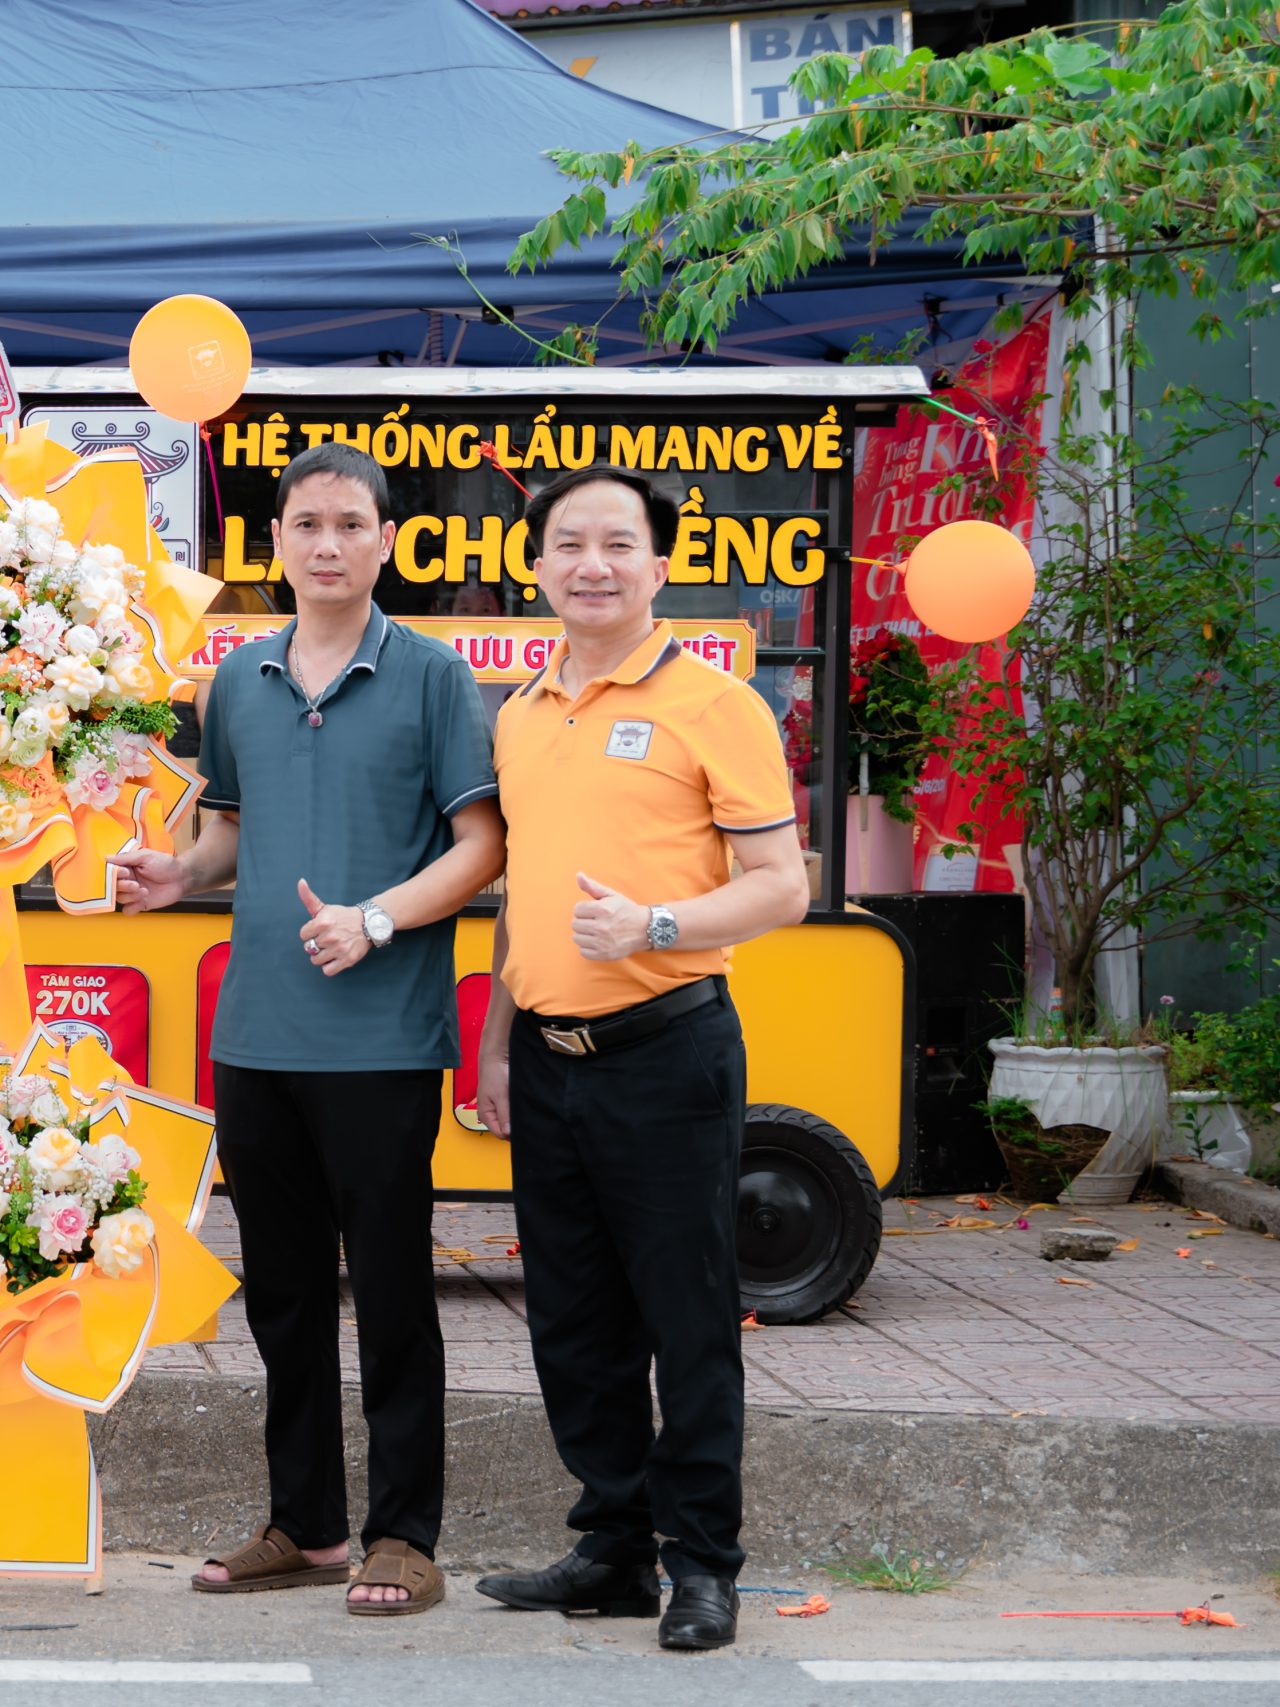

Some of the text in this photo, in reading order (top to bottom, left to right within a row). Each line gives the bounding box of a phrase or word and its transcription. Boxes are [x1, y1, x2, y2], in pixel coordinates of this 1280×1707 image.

[749, 13, 895, 62] BÁN
[223, 403, 843, 478] HỆ THỐNG LẨU MANG VỀ
[668, 486, 826, 586] ỀNG
[192, 625, 245, 665] KẾT
[40, 973, 107, 988] TÂM GIAO
[35, 990, 111, 1016] 270K
